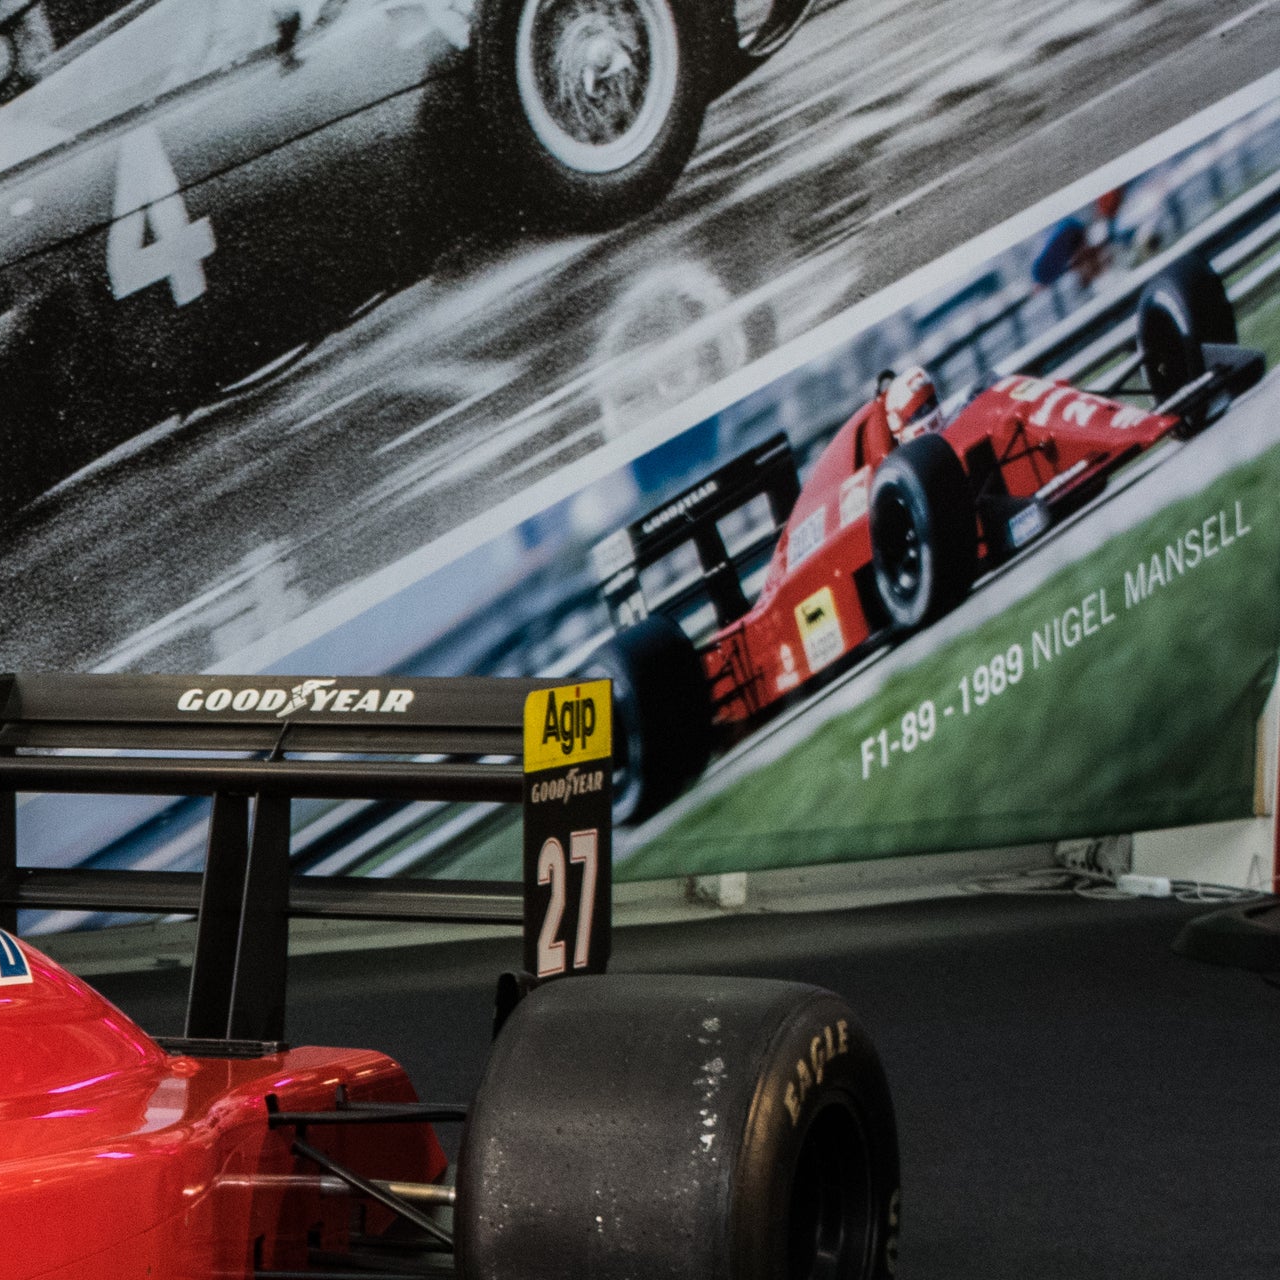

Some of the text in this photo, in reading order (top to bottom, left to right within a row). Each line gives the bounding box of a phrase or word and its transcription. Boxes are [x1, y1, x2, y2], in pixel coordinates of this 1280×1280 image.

[105, 127, 217, 309] 4
[860, 700, 936, 780] F1-89
[958, 644, 1025, 716] 1989
[1030, 586, 1117, 670] NIGEL
[1123, 499, 1252, 611] MANSELL
[178, 683, 415, 716] GOODYEAR
[542, 685, 597, 755] Agip
[531, 769, 604, 804] GOODYEAR
[537, 828, 600, 978] 27
[783, 1019, 849, 1126] EAGLE
